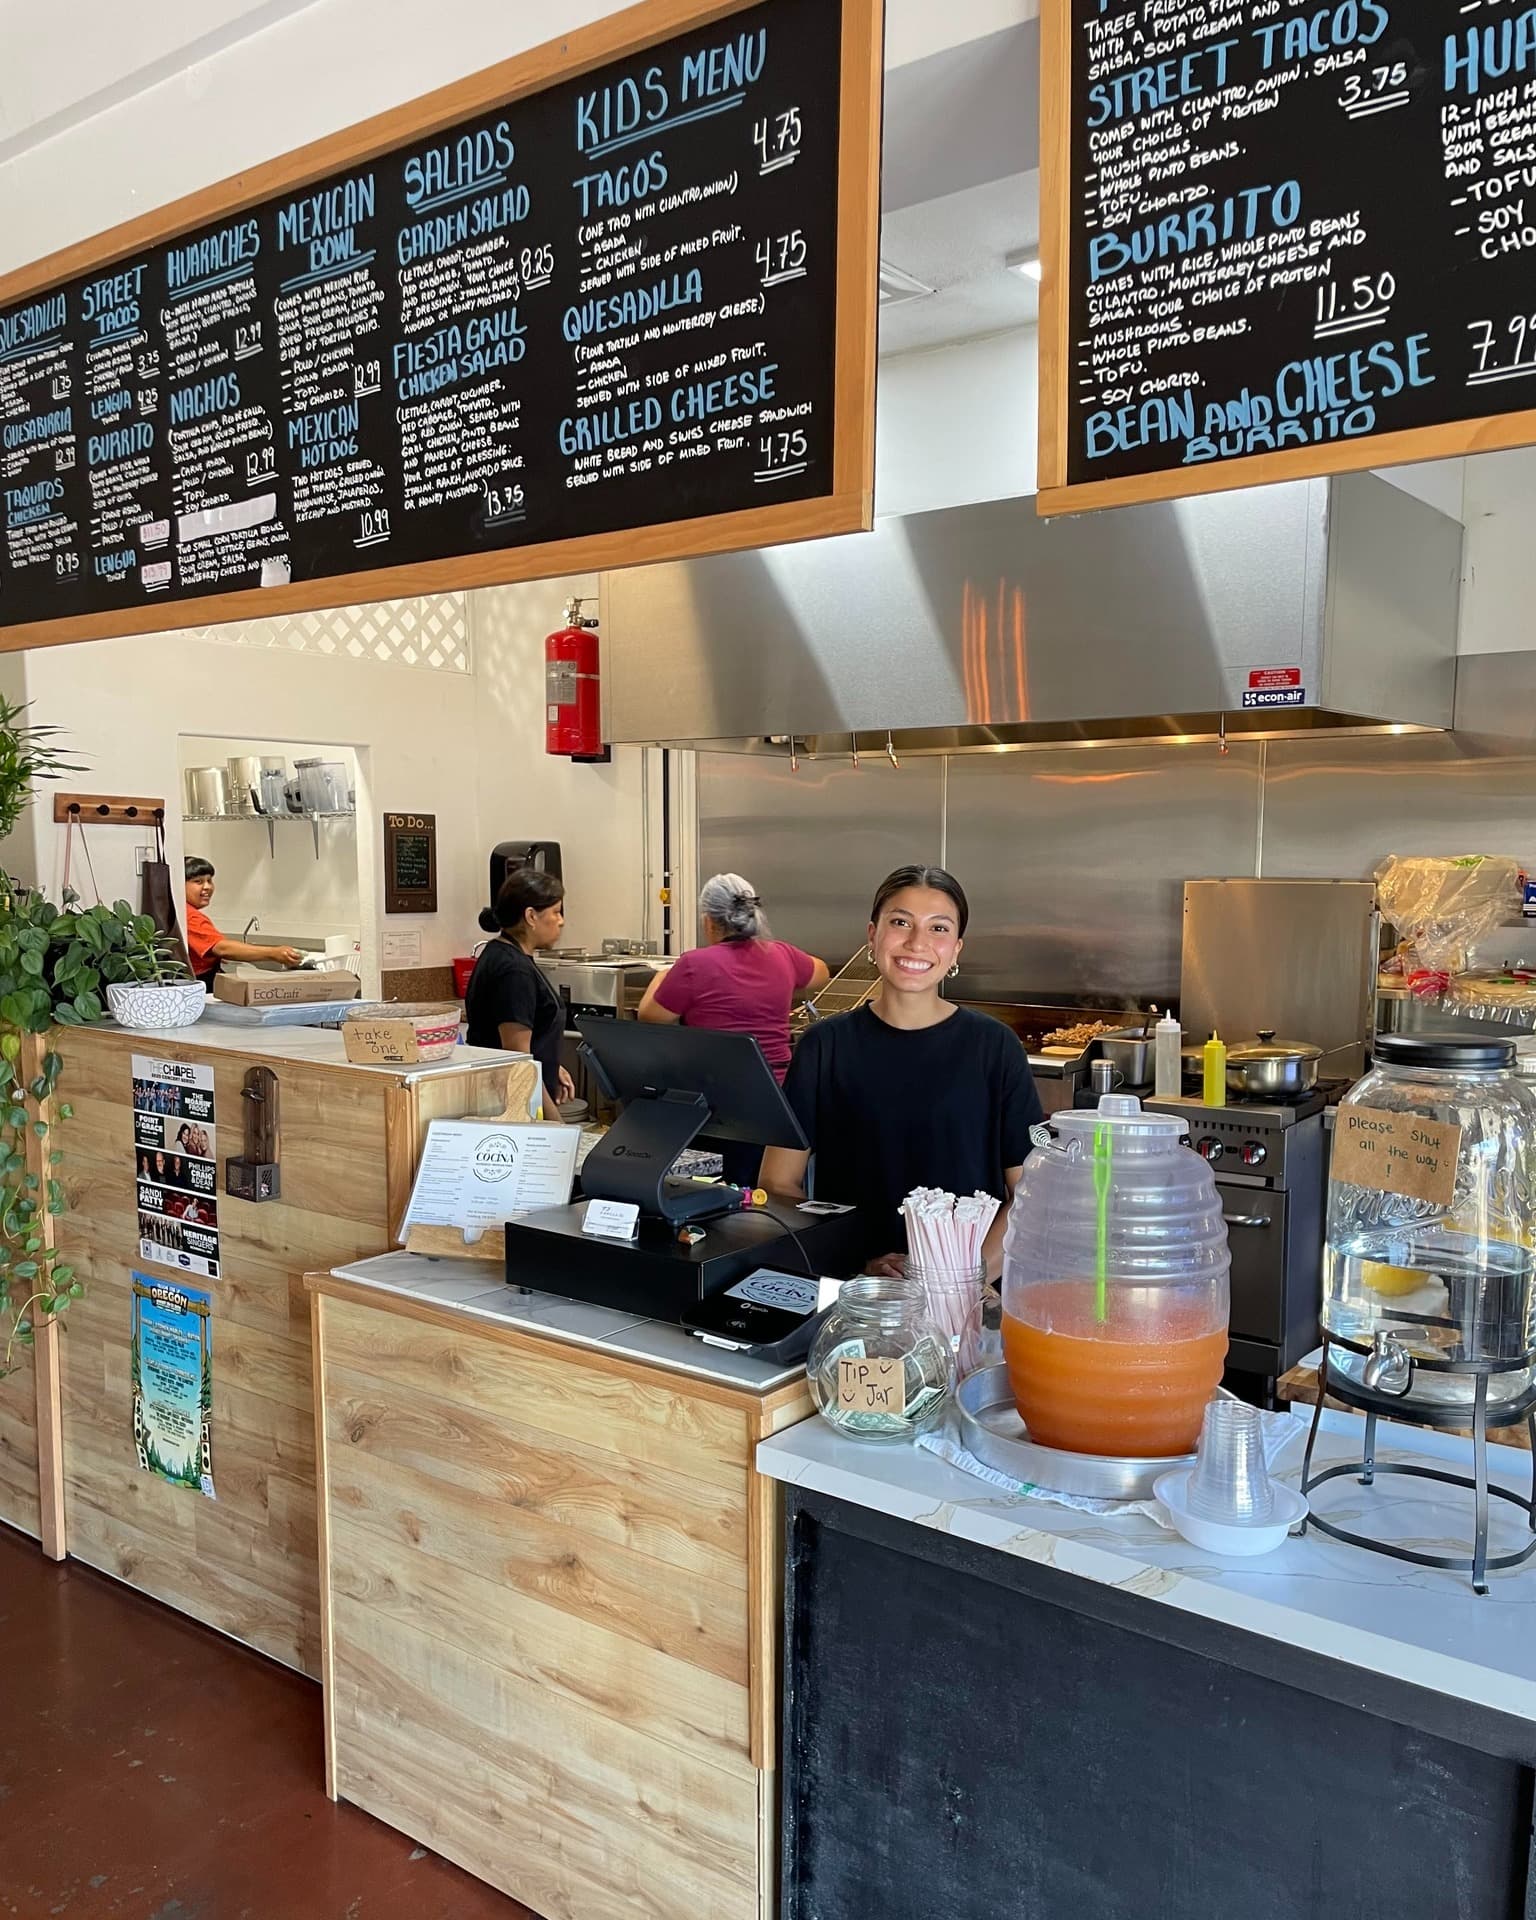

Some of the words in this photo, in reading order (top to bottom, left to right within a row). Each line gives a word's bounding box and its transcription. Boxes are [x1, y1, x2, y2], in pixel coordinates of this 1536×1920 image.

[1083, 12, 1136, 37] THREE
[1088, 52, 1140, 80] SALSA,
[1143, 33, 1186, 59] SOUR
[1193, 17, 1243, 40] CREAM
[1252, 2, 1280, 20] AND
[1087, 39, 1239, 127] STREET
[1252, 0, 1389, 70] TACOS
[1088, 40, 1123, 61] WITH
[577, 67, 669, 151] KIDS
[681, 27, 767, 103] MENU
[1089, 122, 1135, 150] COMES
[1141, 109, 1174, 130] WITH
[1314, 48, 1366, 75] SALSA
[1338, 63, 1407, 107] 3.75
[753, 106, 802, 163] 4.75
[1092, 146, 1124, 165] YOUR
[1192, 112, 1212, 132] OF
[1222, 91, 1279, 121] PROTEIN
[1441, 118, 1481, 146] WITH
[404, 121, 515, 205] SALADS
[1443, 138, 1484, 161] SOUR
[572, 150, 668, 218] TACOS
[1100, 174, 1141, 199] WHOLE
[1148, 162, 1185, 183] PINTO
[1445, 158, 1481, 178] AND
[279, 173, 375, 252] MEXICAN
[397, 205, 468, 266] GARDEN
[470, 184, 530, 237] SALAD
[608, 213, 631, 232] TACO
[635, 204, 656, 221] WITH
[1102, 211, 1133, 229] SOY
[1478, 199, 1523, 233] SOY
[594, 234, 626, 256] ASADA
[1089, 180, 1301, 283] BURRITO
[168, 219, 260, 288] HUARACHES
[310, 227, 362, 272] BOWL
[521, 243, 554, 281] 8.25
[579, 273, 612, 294] SERVED
[617, 264, 636, 280] WITH
[640, 256, 661, 272] SIDE
[664, 248, 678, 262] OF
[680, 236, 709, 256] MIXED
[755, 229, 807, 279] 4.75
[1086, 276, 1134, 299] COMES
[1141, 264, 1175, 287] WITH
[1221, 237, 1266, 265] WHOLE
[1268, 228, 1306, 249] PINTO
[1309, 210, 1361, 237] BEANS
[1168, 260, 1255, 292] MONTERREY
[1257, 242, 1320, 271] CHEESE
[1327, 229, 1366, 254] AND
[81, 263, 148, 321] STREET
[562, 267, 703, 342] QUESADILLA
[1148, 298, 1184, 319] YOUR
[1192, 282, 1241, 307] CHOICE
[1269, 258, 1331, 290] PROTEIN
[1317, 271, 1396, 322] 11.50
[95, 300, 139, 335] TACOS
[235, 321, 261, 350] 12.99
[393, 325, 461, 379] FIESTA
[466, 306, 528, 352] GRILL
[606, 332, 640, 352] TORTILLA
[644, 325, 661, 340] AND
[1092, 343, 1141, 366] WHOLE
[1148, 333, 1191, 355] PINTO
[137, 350, 160, 372] 3.75
[353, 360, 381, 391] 12.99
[398, 357, 458, 401] CHICKEN
[460, 337, 526, 378] SALAD
[587, 365, 628, 390] CHICKEN
[589, 356, 621, 374] ASADA
[170, 371, 241, 425] NACHOS
[576, 391, 612, 409] SERVED
[617, 379, 640, 397] WITH
[645, 371, 670, 388] SIDE
[675, 362, 689, 379] OF
[694, 353, 726, 374] MIXED
[1086, 387, 1195, 460] BEAN
[1204, 387, 1273, 434] AND
[1277, 333, 1436, 419] CHEESE
[1101, 388, 1133, 407] SOY
[91, 389, 132, 420] LENGUA
[559, 396, 661, 456] GRILLED
[671, 363, 779, 423] CHEESE
[3, 406, 72, 449] QUESABIRRIA
[288, 401, 359, 450] MEXICAN
[574, 454, 602, 471] WHITE
[607, 445, 637, 463] BREAD
[643, 436, 663, 452] AND
[669, 428, 704, 445] SWISS
[710, 414, 753, 433] CHEESE
[759, 401, 812, 424] SANDWICH
[1182, 404, 1376, 463] BURRITO
[88, 422, 154, 465] BURRITO
[246, 446, 275, 476] 12.99
[302, 442, 328, 469] HOT
[329, 435, 359, 462] DOG
[760, 428, 808, 468] 4.75
[566, 470, 599, 489] SERVED
[603, 463, 625, 478] WITH
[630, 455, 652, 472] SIDE
[659, 449, 674, 465] OF
[679, 441, 711, 460] MIXED
[3, 477, 65, 511] TAQUITOS
[487, 485, 525, 517] 13.75
[7, 502, 51, 525] CHICKEN
[361, 508, 390, 538] 10.99
[55, 552, 80, 576] 8.95
[95, 549, 136, 576] LENGUA
[388, 816, 405, 828] To
[353, 1028, 392, 1040] take
[371, 1044, 399, 1054] one
[163, 1064, 196, 1079] CHAPEL
[1349, 1117, 1394, 1134] please
[188, 1162, 215, 1174] PHILLIPS
[476, 1152, 514, 1163] COCINA
[1359, 1140, 1375, 1152] all
[1387, 1146, 1409, 1160] the
[1416, 1153, 1438, 1173] way
[152, 1288, 187, 1307] OREGON
[841, 1361, 869, 1384] Tip
[866, 1384, 893, 1407] Jar
